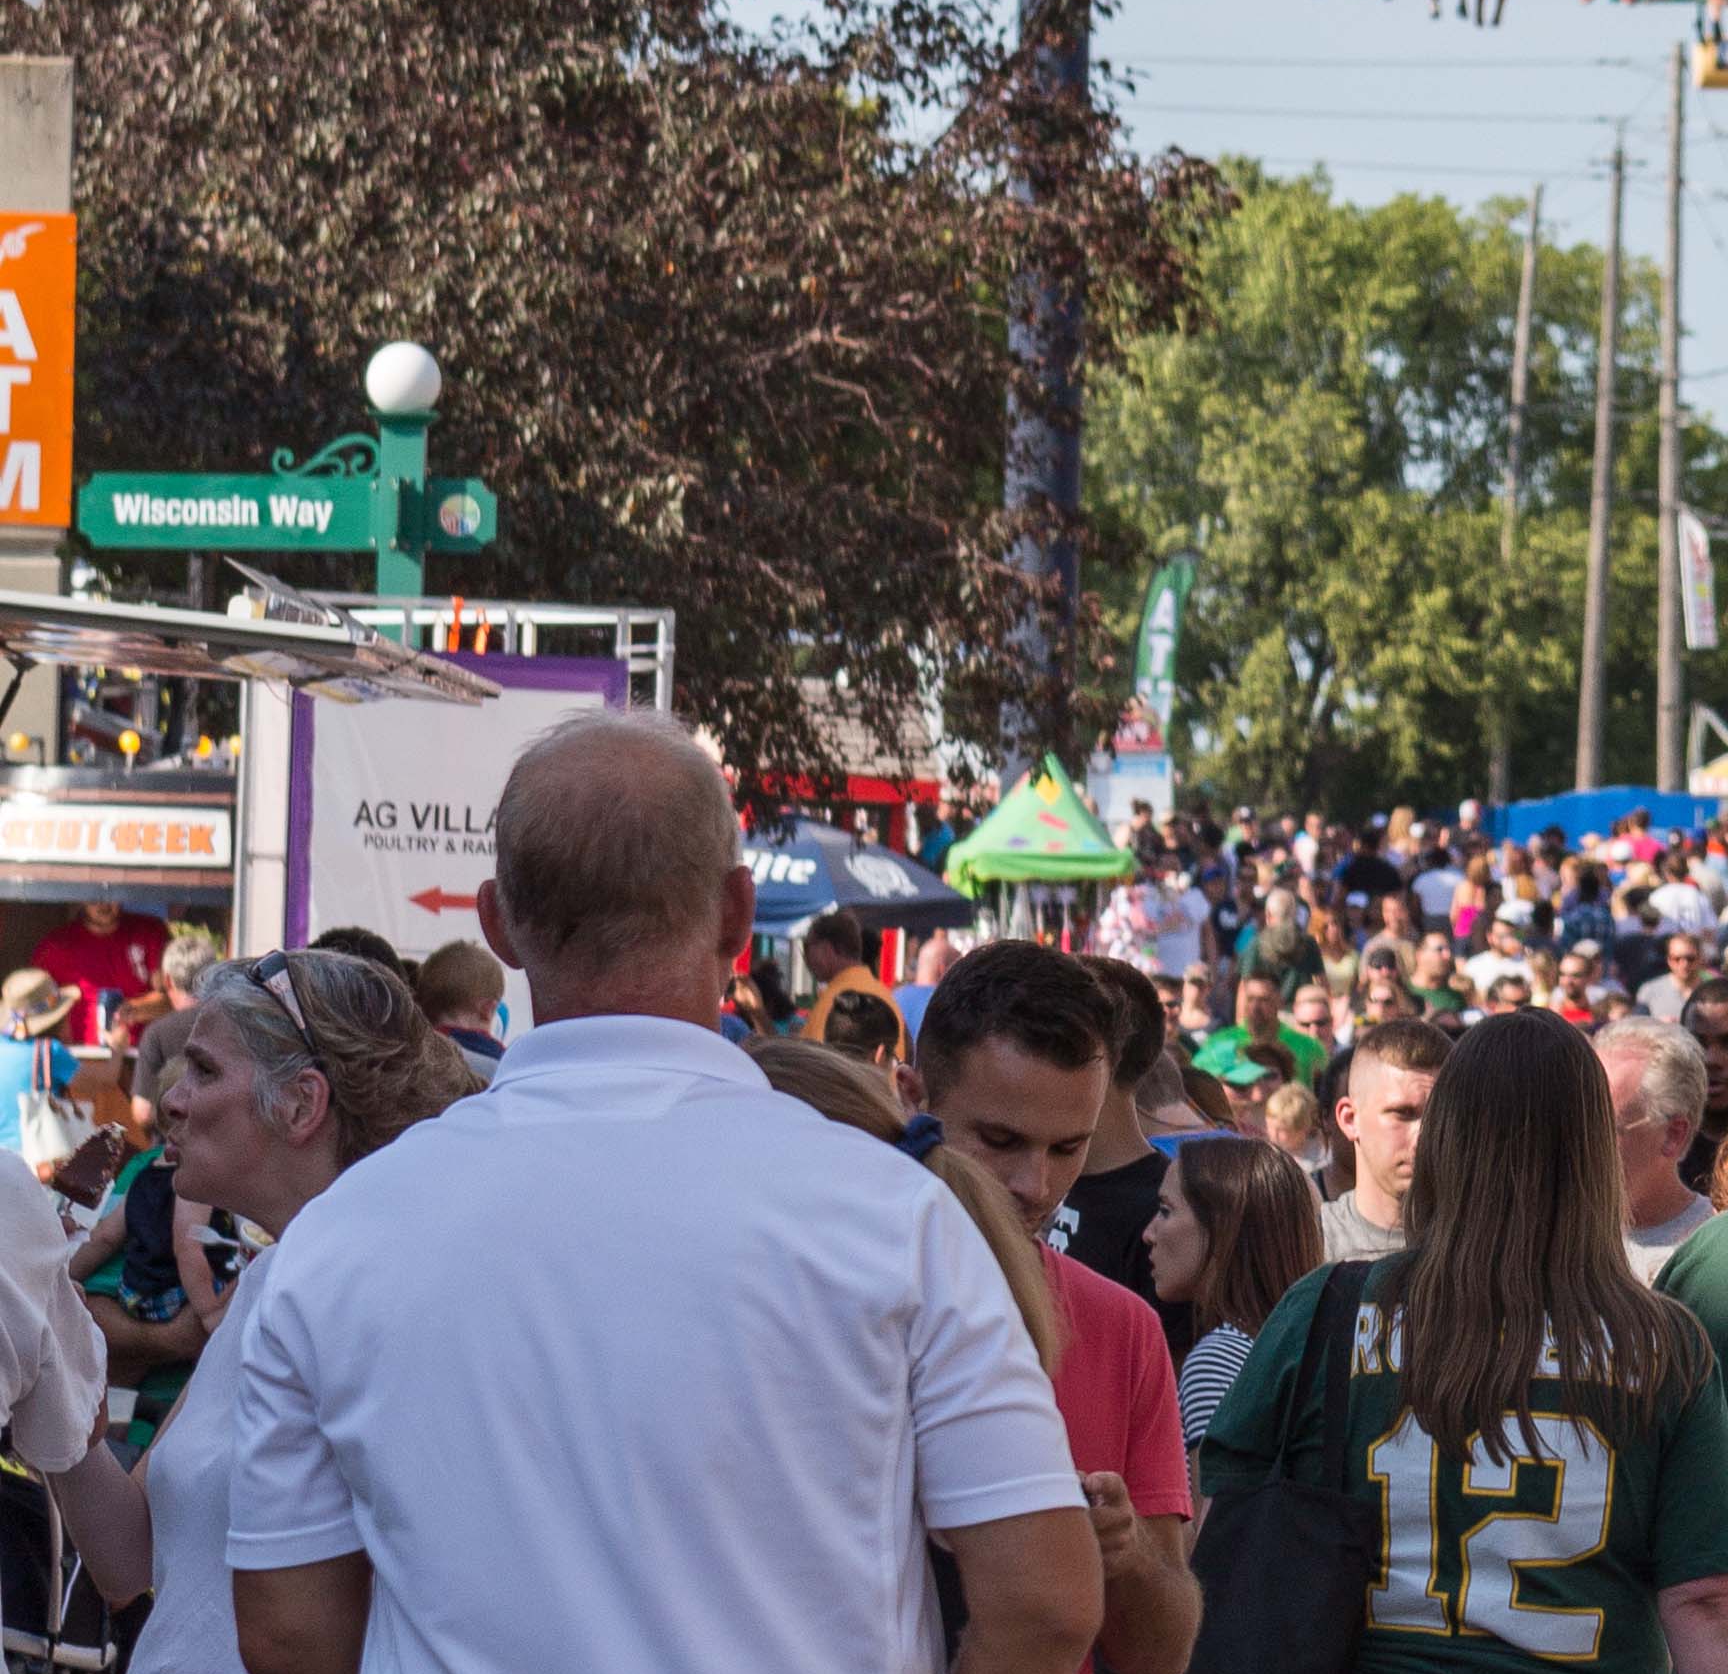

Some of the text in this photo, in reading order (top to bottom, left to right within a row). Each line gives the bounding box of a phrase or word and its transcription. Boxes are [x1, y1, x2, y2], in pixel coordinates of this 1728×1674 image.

[113, 492, 333, 533] Wisconsin Way
[353, 800, 397, 828] AG
[364, 833, 438, 853] POULTRY
[445, 839, 456, 853] &
[1367, 1406, 1616, 1662] 12
